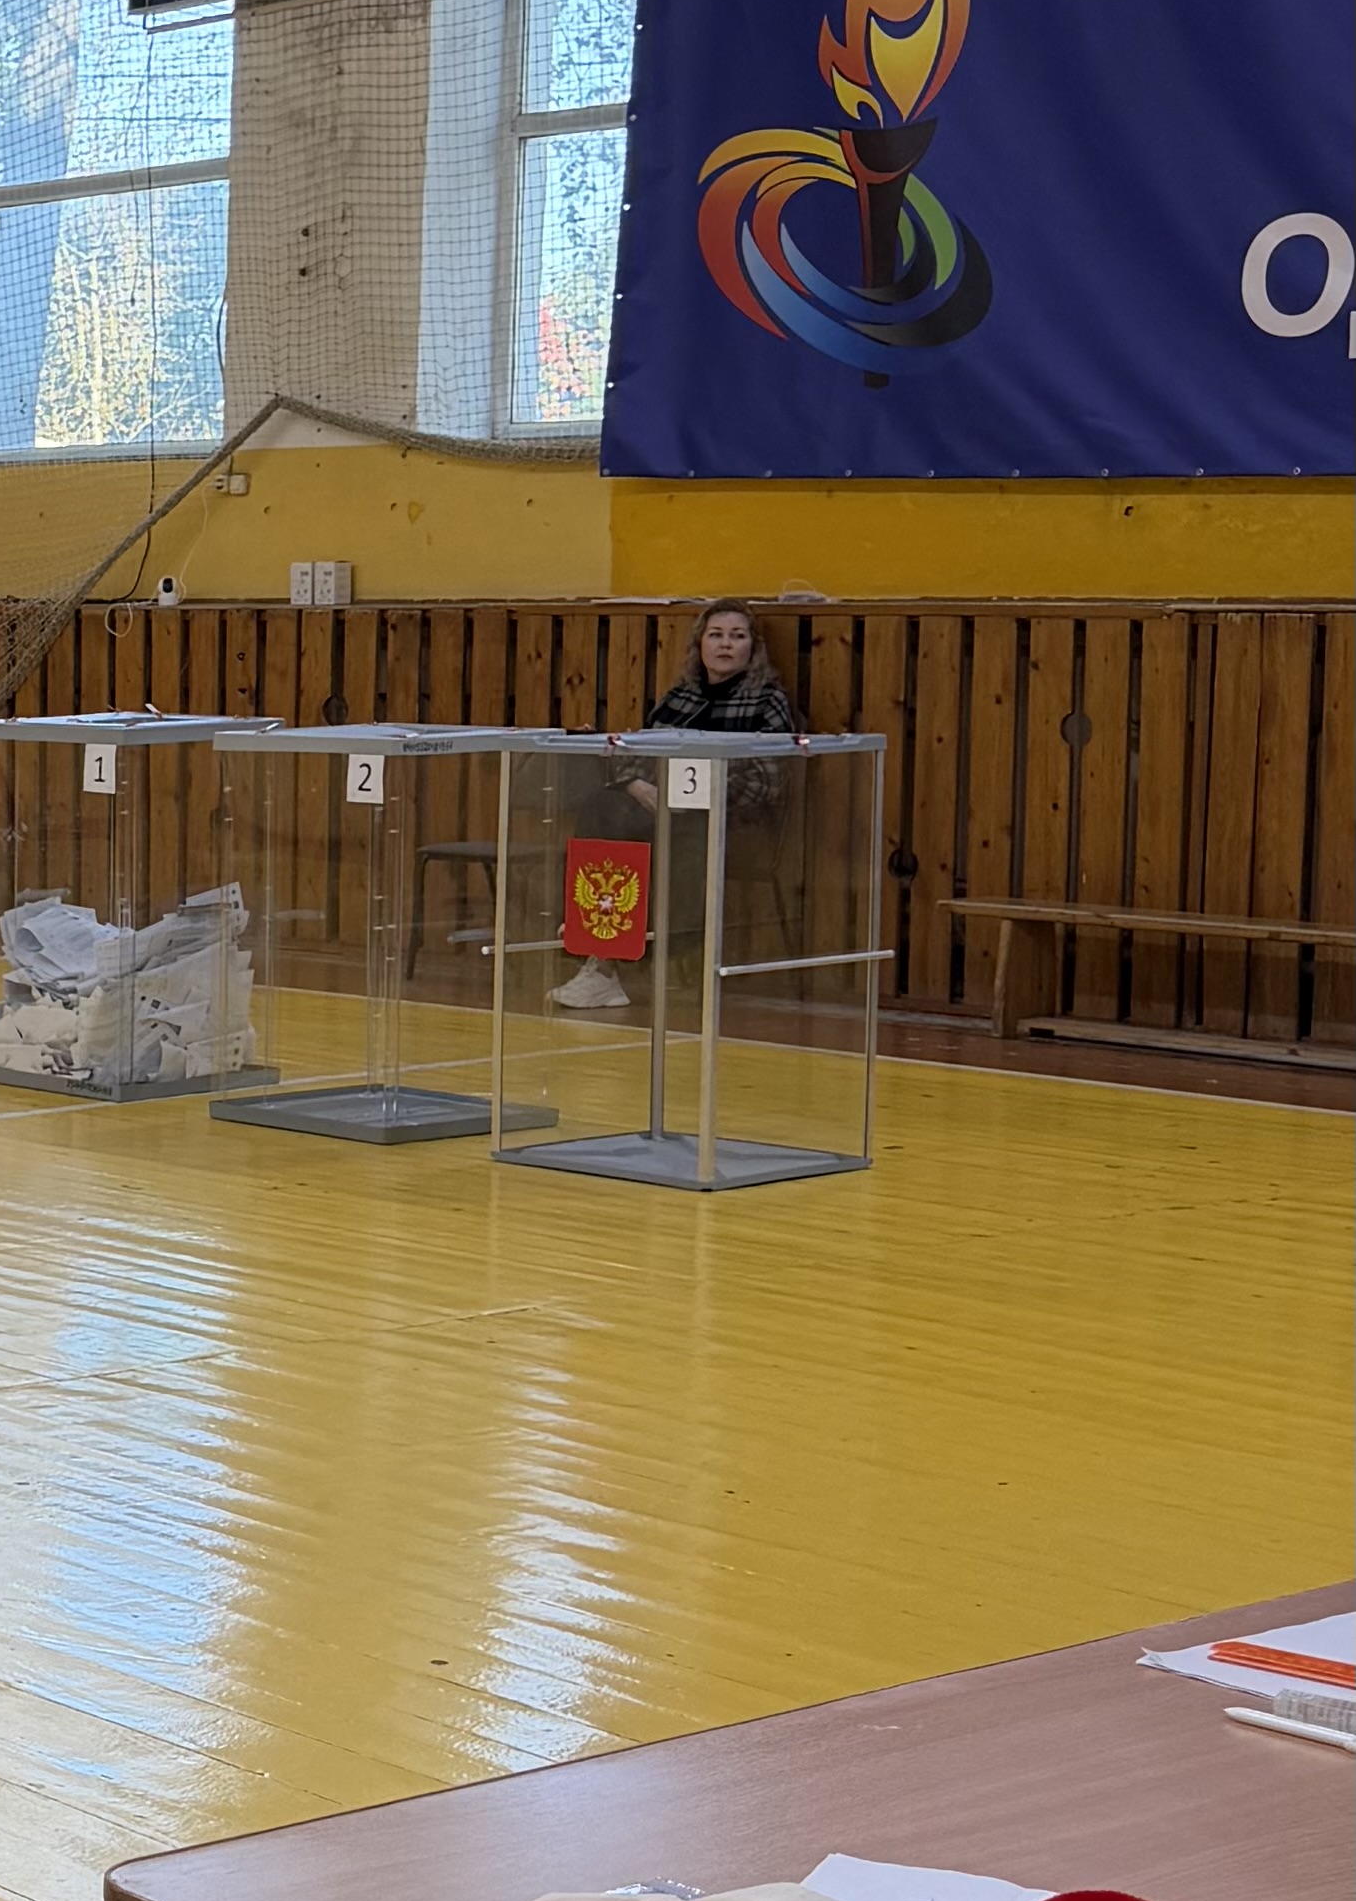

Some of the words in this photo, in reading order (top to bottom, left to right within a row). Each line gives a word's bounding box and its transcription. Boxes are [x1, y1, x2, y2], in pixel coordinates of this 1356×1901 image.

[1241, 212, 1355, 360] О
[94, 756, 106, 783] 1
[357, 762, 372, 792] 2
[683, 766, 697, 794] 3
